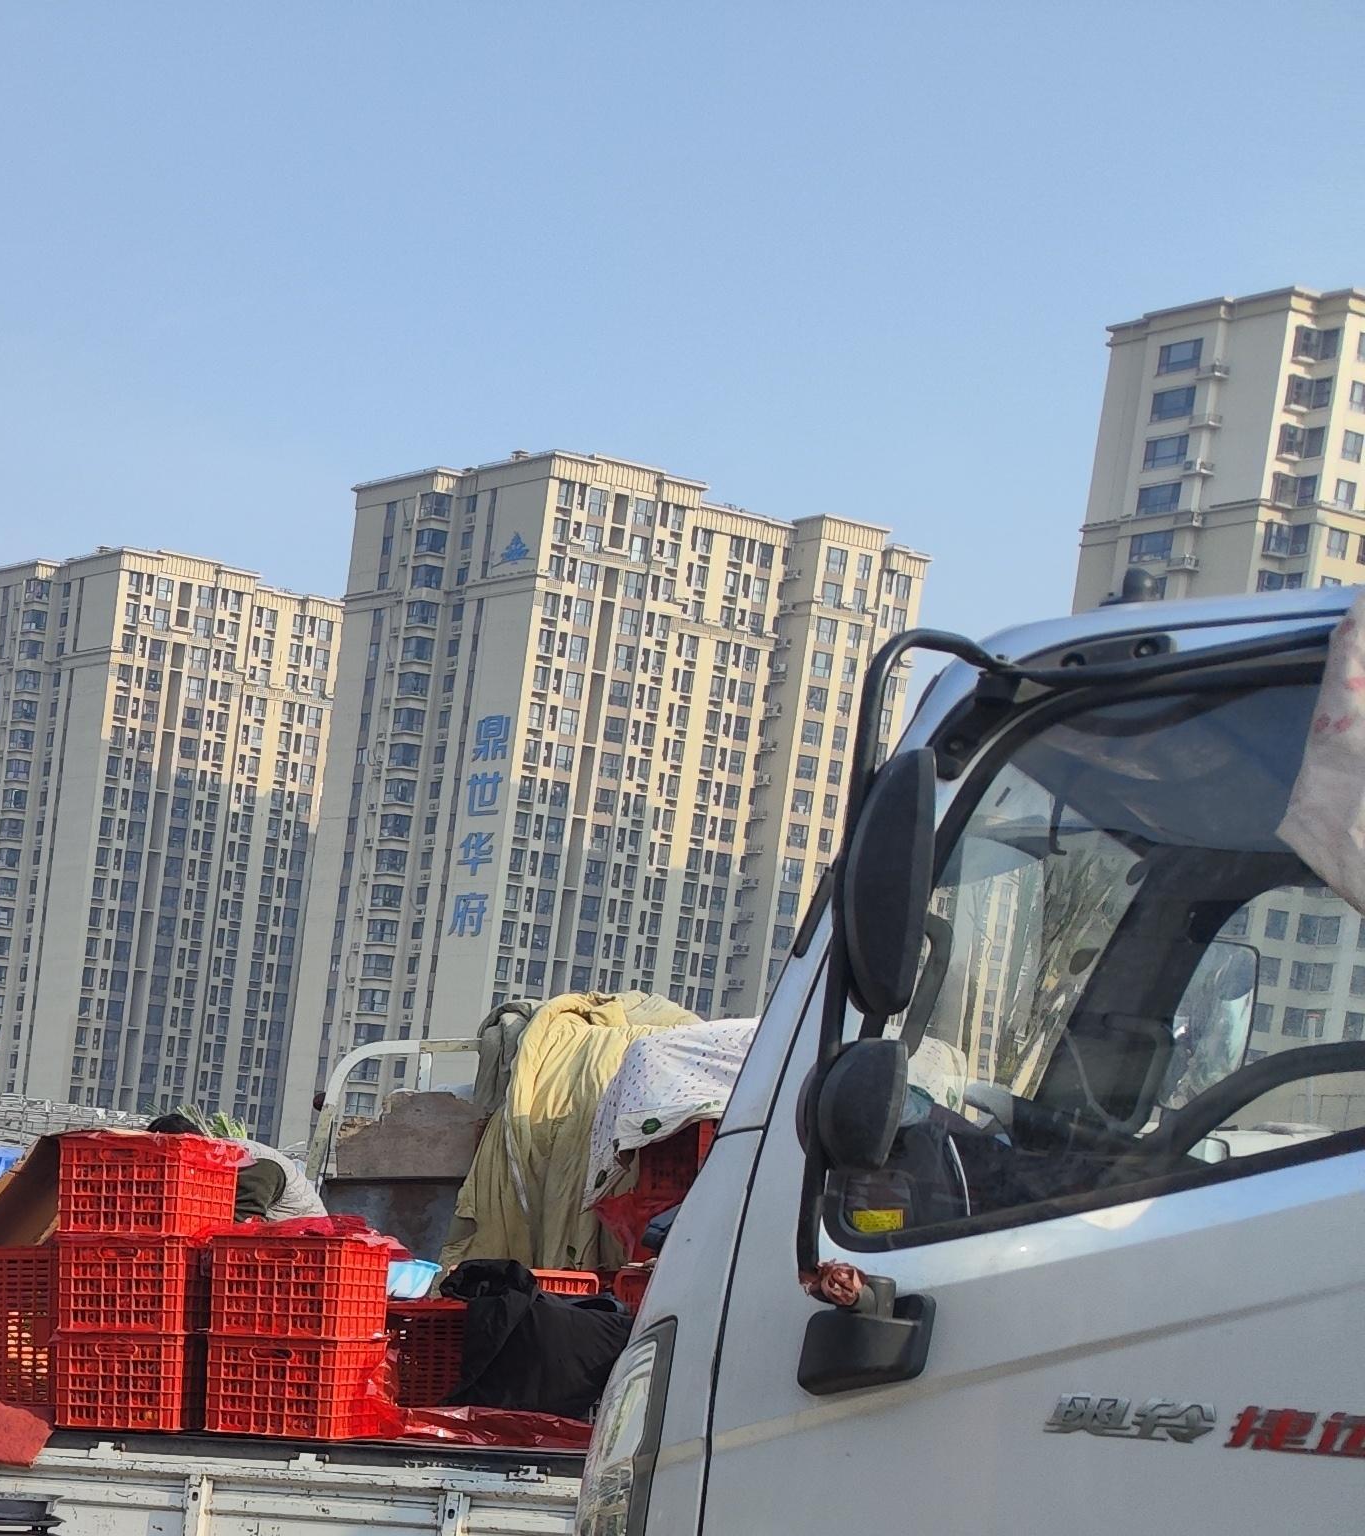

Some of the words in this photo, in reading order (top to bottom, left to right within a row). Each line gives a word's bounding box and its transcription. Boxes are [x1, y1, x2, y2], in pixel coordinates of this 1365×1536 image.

[447, 714, 512, 939] 鼎世华府
[1043, 1391, 1217, 1443] 奥铃
